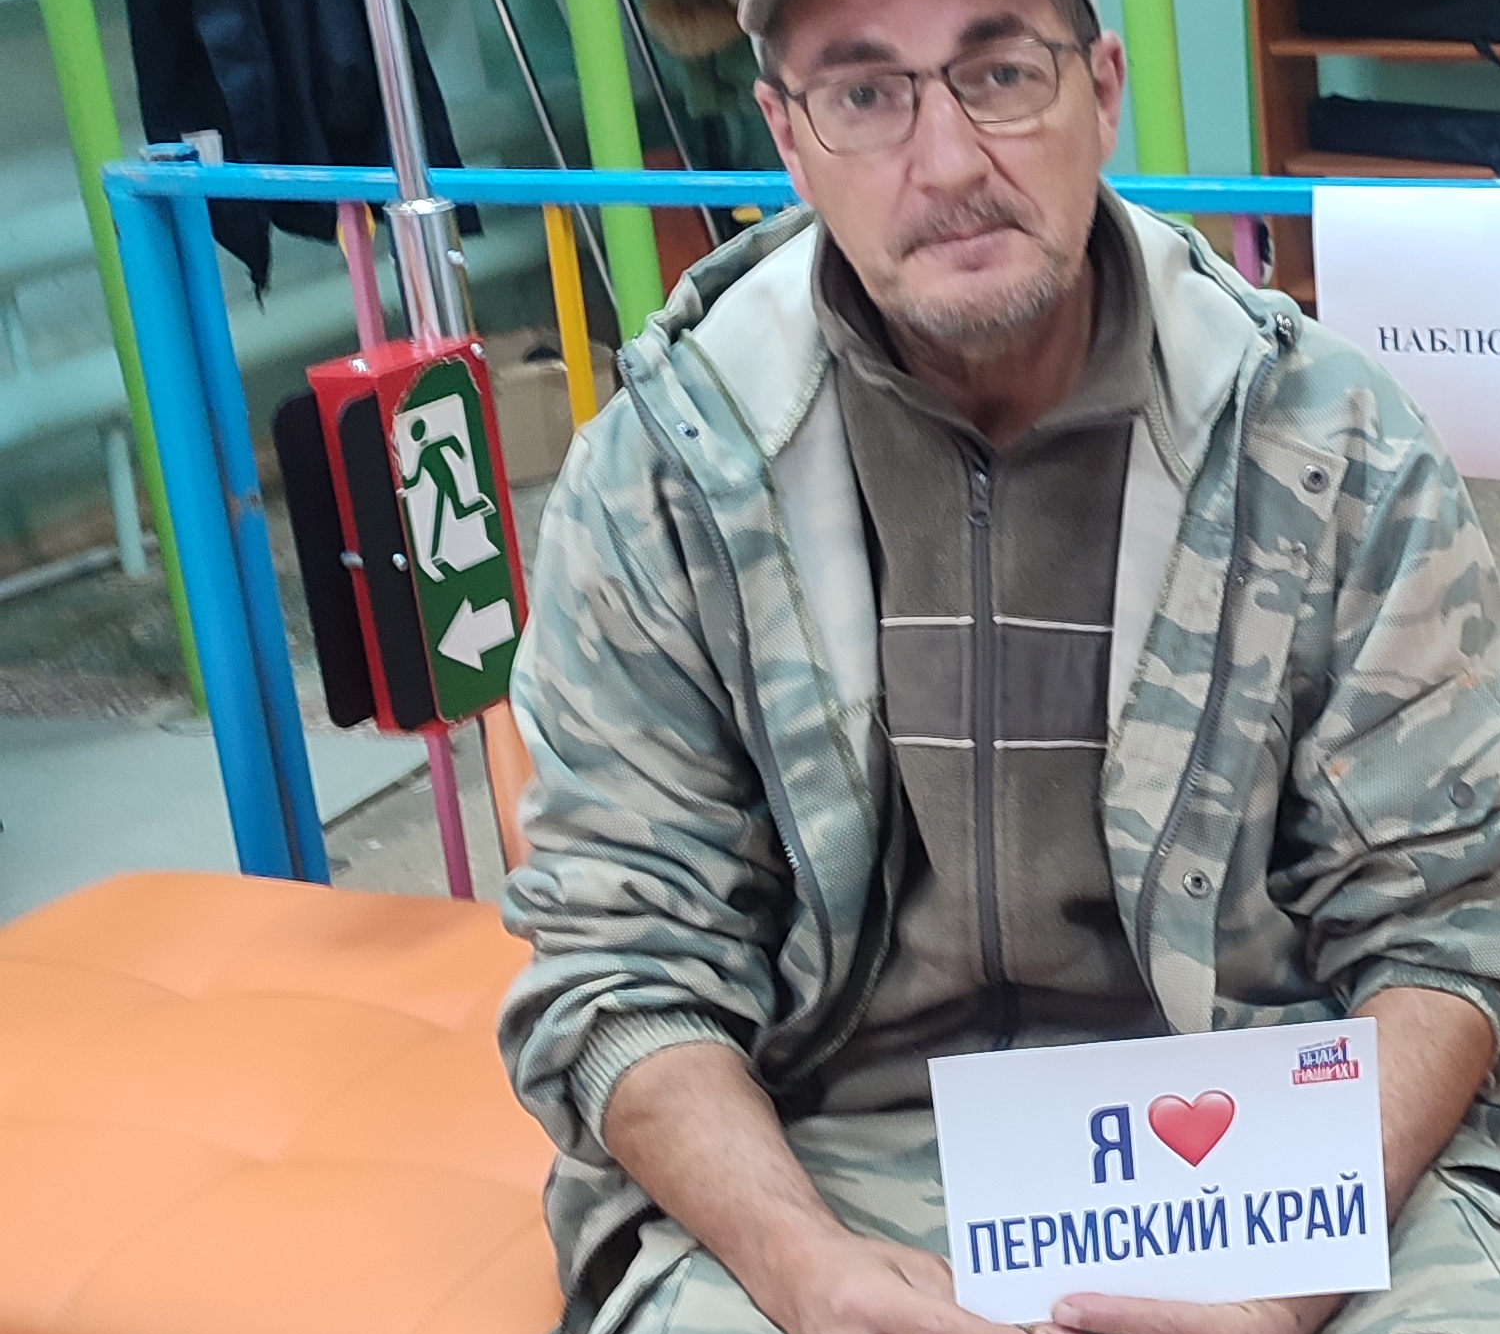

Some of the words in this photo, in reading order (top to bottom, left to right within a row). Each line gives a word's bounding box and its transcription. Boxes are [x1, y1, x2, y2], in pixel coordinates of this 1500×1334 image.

[1089, 1103, 1136, 1185] Я
[967, 1184, 1229, 1274] ПЕРМСКИЙ
[1244, 1171, 1367, 1246] КРАЙ
